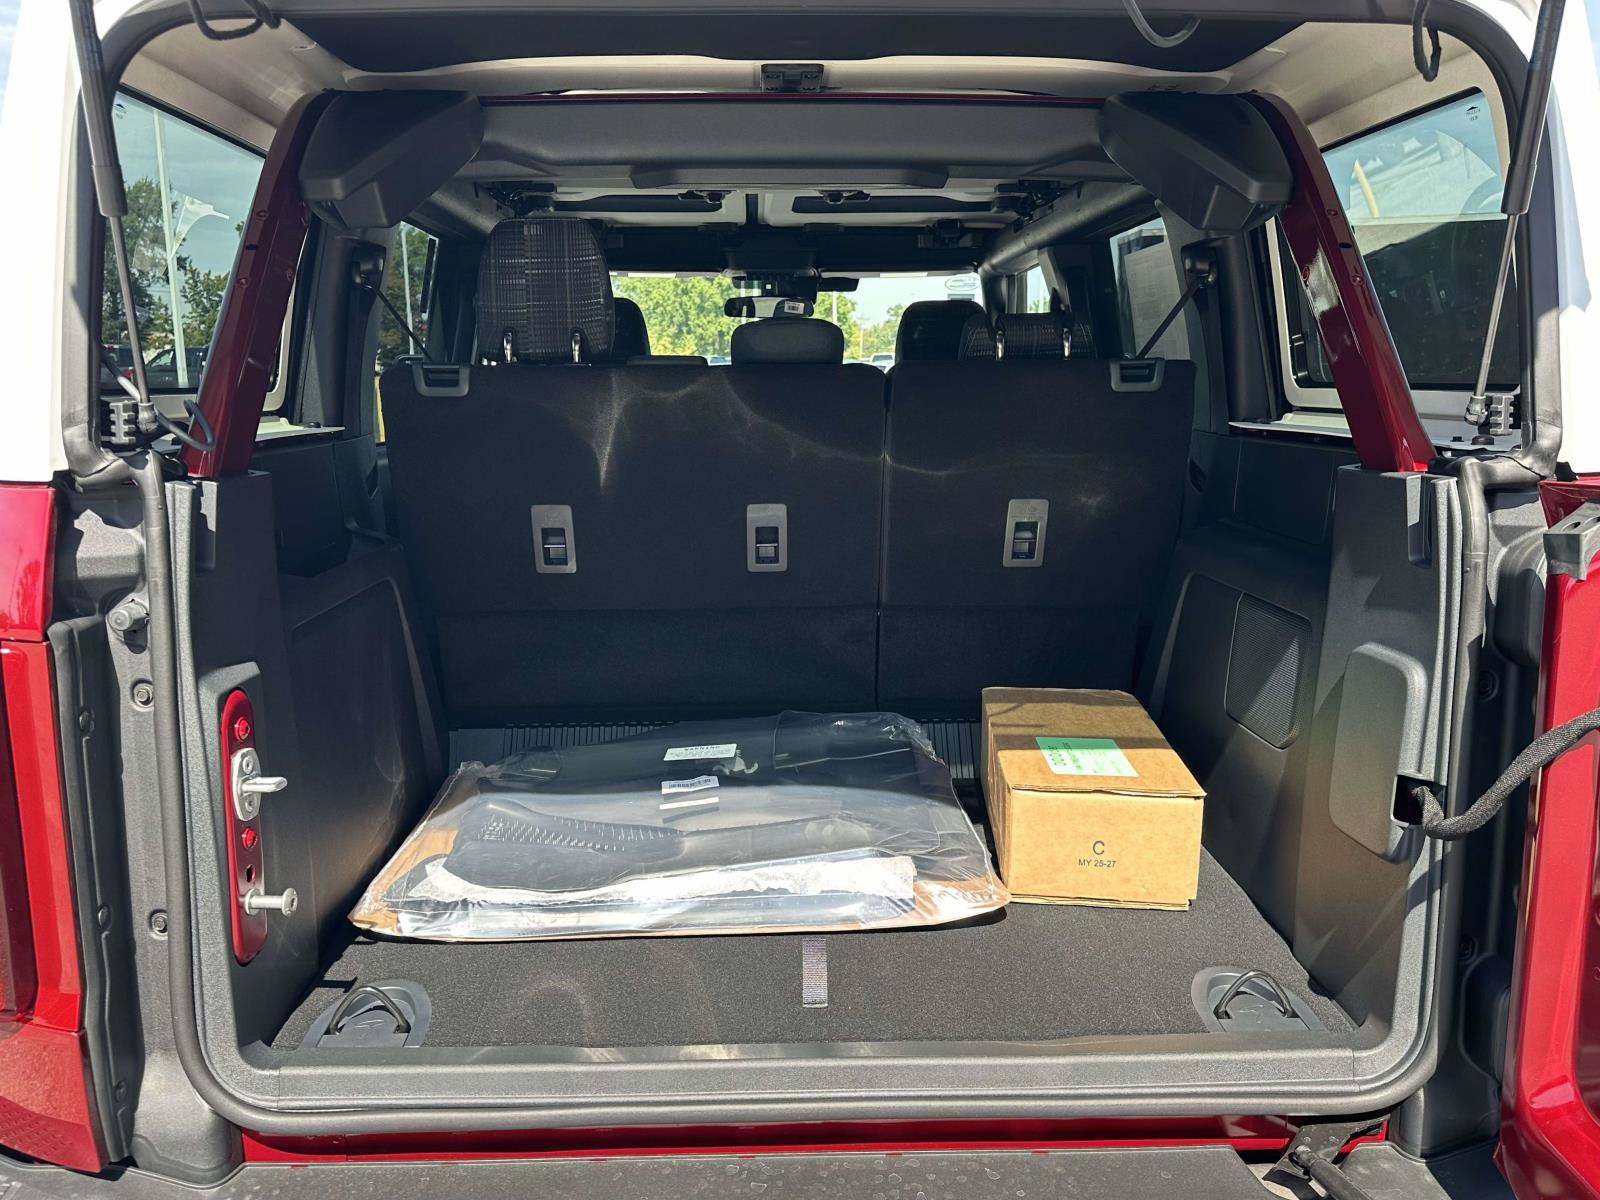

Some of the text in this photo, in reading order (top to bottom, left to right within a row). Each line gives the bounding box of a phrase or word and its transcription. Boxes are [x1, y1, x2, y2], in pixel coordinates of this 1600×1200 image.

[1092, 840, 1105, 855] C
[1078, 859, 1117, 868] MY 25-27
